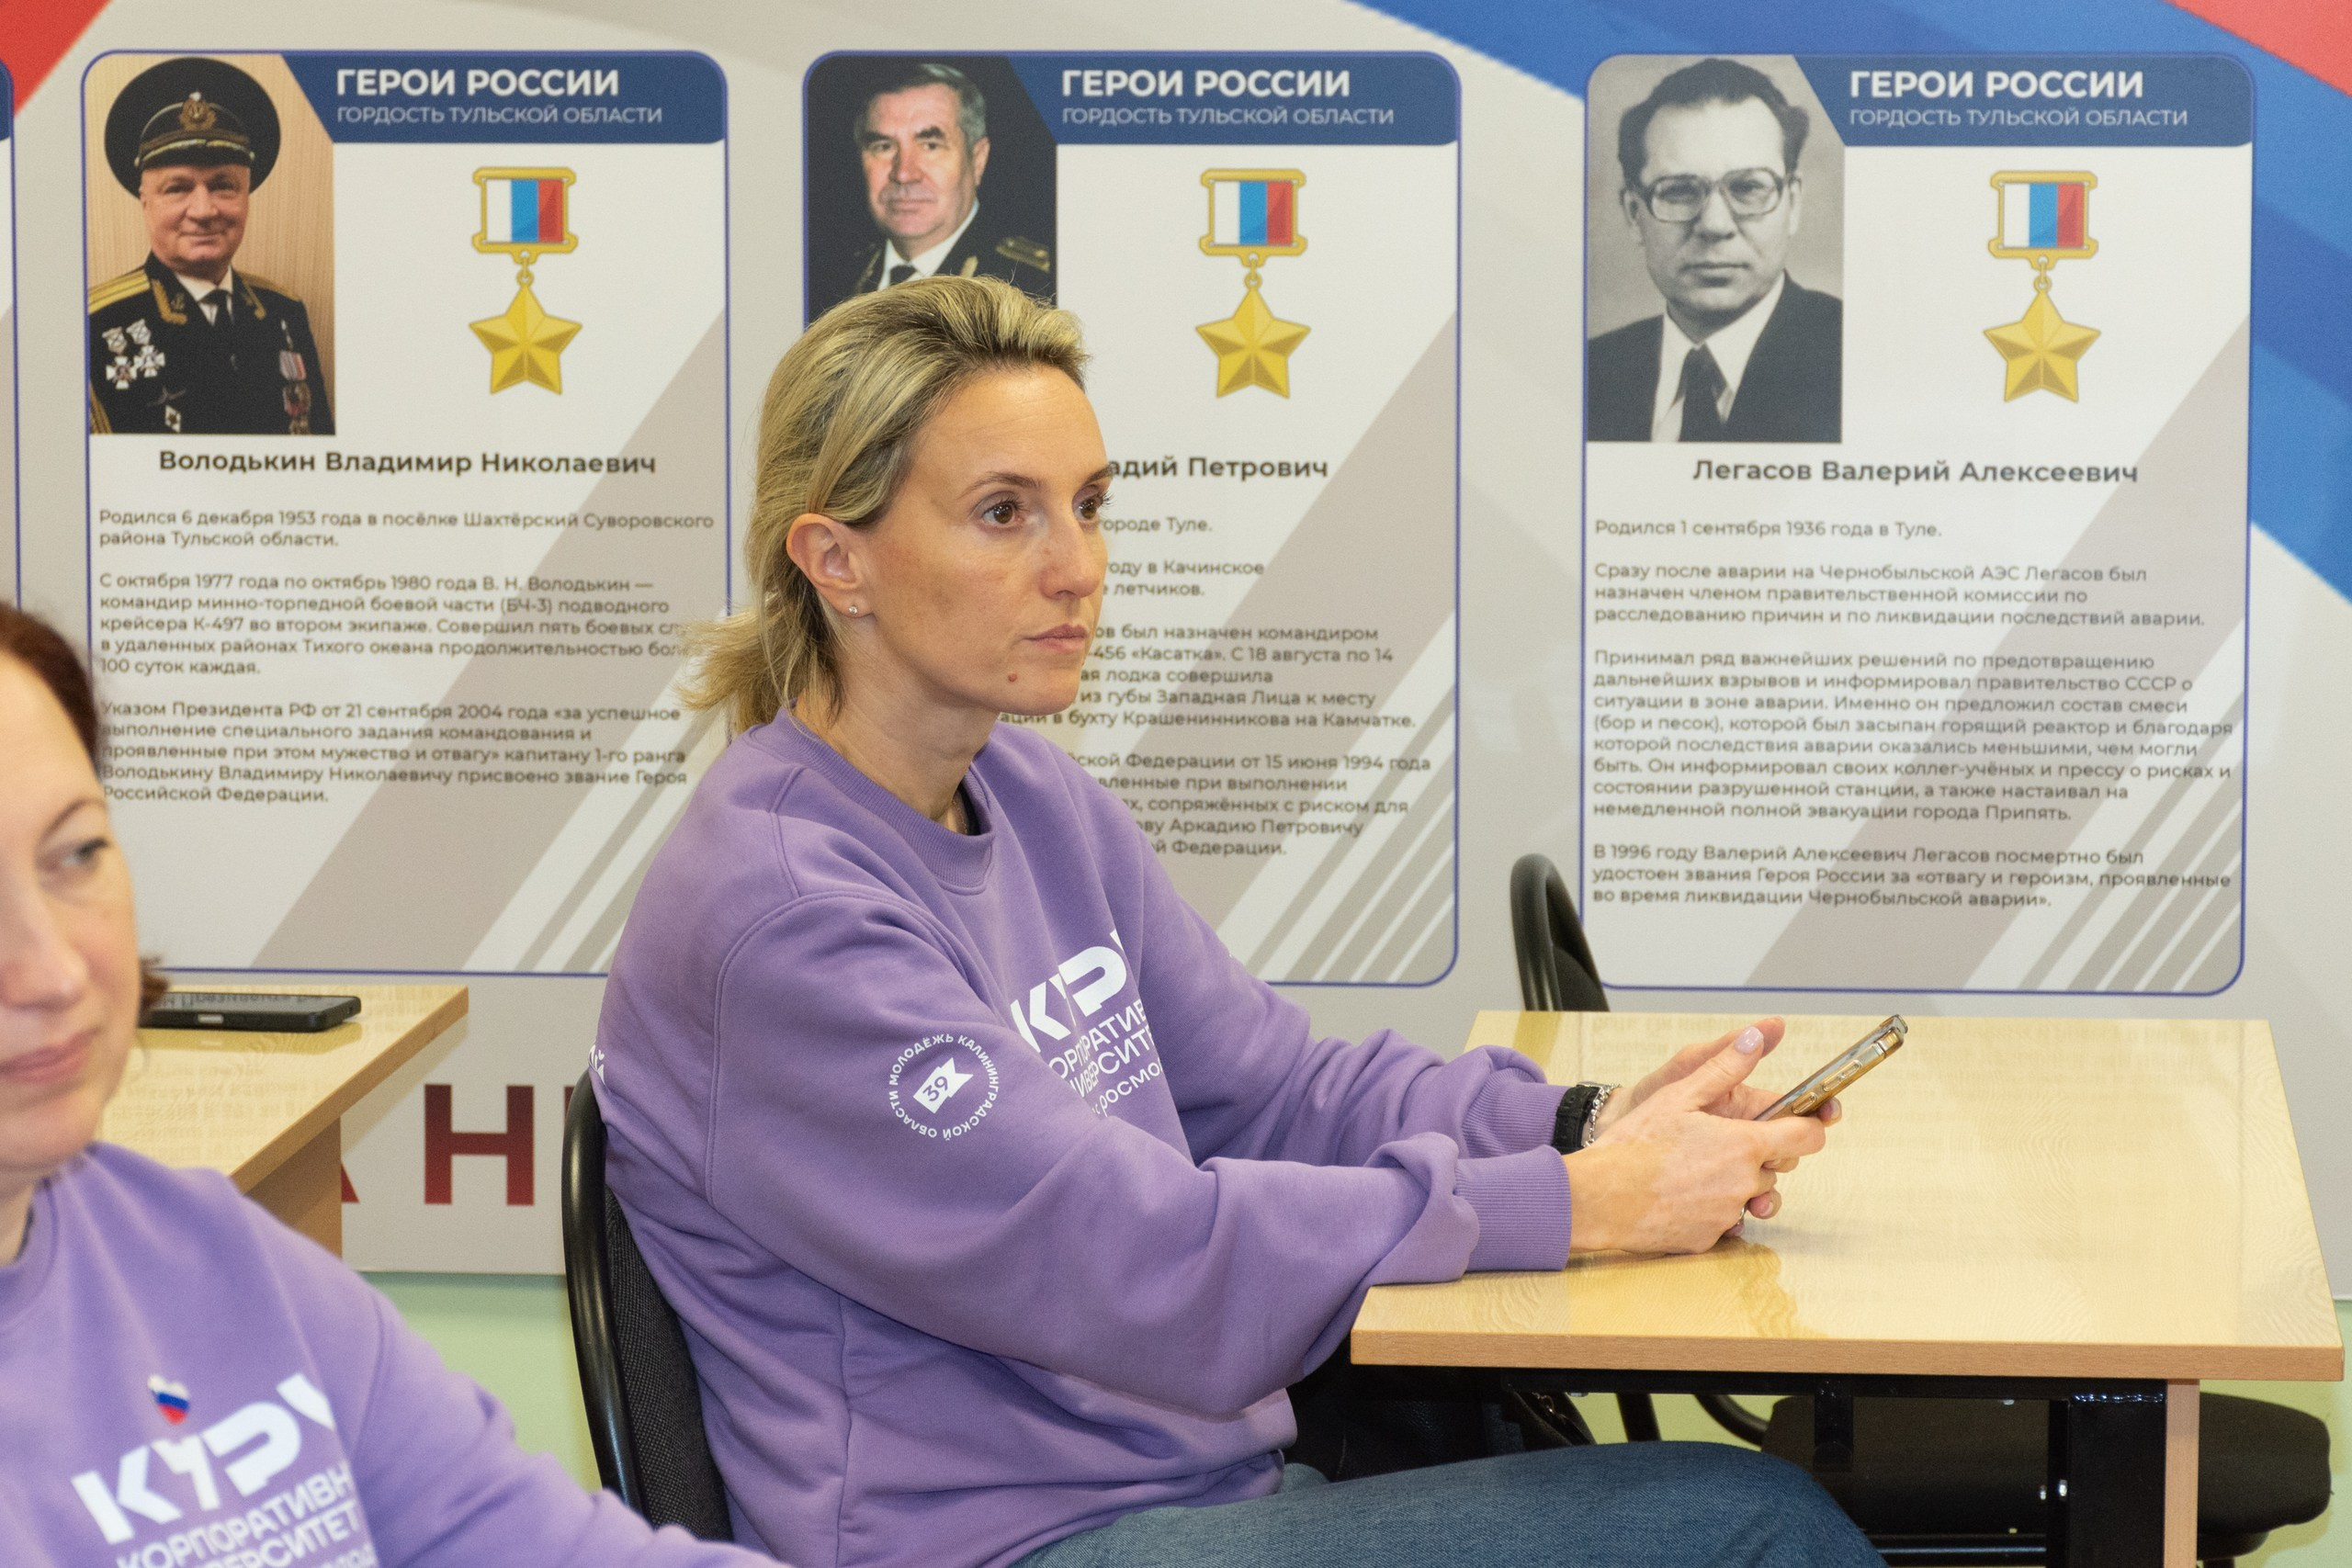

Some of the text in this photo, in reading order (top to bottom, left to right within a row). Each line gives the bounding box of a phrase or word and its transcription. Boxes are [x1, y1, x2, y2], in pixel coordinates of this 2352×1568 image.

[337, 69, 618, 96] ГЕРОИ РОССИИ
[1062, 70, 1350, 97] ГЕРОИ РОССИИ
[1850, 71, 2143, 98] ГЕРОИ РОССИИ
[337, 105, 662, 125] ГОРДОСТЬ ТУЛЬСКОЙ ОБЛАСТИ
[1062, 106, 1395, 126] ГОРДОСТЬ ТУЛЬСКОЙ ОБЛАСТИ
[1849, 107, 2188, 128] ГОРДОСТЬ ТУЛЬСКОЙ ОБЛАСТИ
[159, 450, 656, 478] Володькин Владимир Николаевич
[1188, 456, 1328, 482] Петрович
[1691, 459, 2139, 486] Легасов Валерий Алексеевич
[98, 509, 715, 532] Родился 6 декабря 1953 года в посёлке Шахтёрский Суворовского
[1099, 515, 1212, 535] ороде Туле.
[1594, 518, 1942, 540] Родился 1 сентября 1936 года в Туле.
[98, 529, 339, 549] района Тульской области.
[1146, 559, 1265, 576] в Качинское
[1593, 561, 2148, 582] Сразу после аварии на Чернобыльской АЭС Легасов был
[1113, 582, 1204, 597] летчиков.
[1593, 586, 2088, 604] назначен членом правительственной комиссии по
[99, 596, 670, 615] командир минно-торпедной боевой части (БЧ-3) подводного
[99, 615, 654, 636] крейсера К-497 во втором экипаже. Совершил пять боевых
[1593, 608, 2205, 629] расследованию причин и по ликвидации последствий аварии.
[1120, 623, 1379, 644] был назначен командиром
[98, 657, 261, 676] 100 суток каждая.
[1130, 646, 1395, 666] «Касатка». С 18 августа по 14
[1593, 649, 2155, 671] Принимал ряд важнейших решений по предотвращению
[1105, 670, 1274, 685] лодка совершила
[1080, 687, 1376, 709] из губы Западная Лица к месту
[1125, 752, 1431, 772] Федерации от 15 июня 1994 года
[218, 765, 324, 784] Владимиру
[328, 766, 454, 785] Николаевичу
[457, 770, 560, 785] присвоено
[564, 772, 631, 784] звание
[636, 770, 687, 785] Героя
[1184, 777, 1349, 793] при выполнении
[215, 786, 329, 804] Федерации.
[1592, 801, 2072, 822] немедленной полной эвакуации города Припять.
[1169, 817, 1366, 838] Аркадию Петровичу
[1170, 839, 1287, 858] Федерации.
[1591, 888, 2052, 909] во время ликвидации Чернобыльской аварии».
[889, 1034, 999, 1141] МОЛОДЁЖЬ КАЛИНИНГРАДСКОЙ ОБЛАСТИ
[922, 1076, 948, 1102] 39
[1099, 1058, 1162, 1117] росмо
